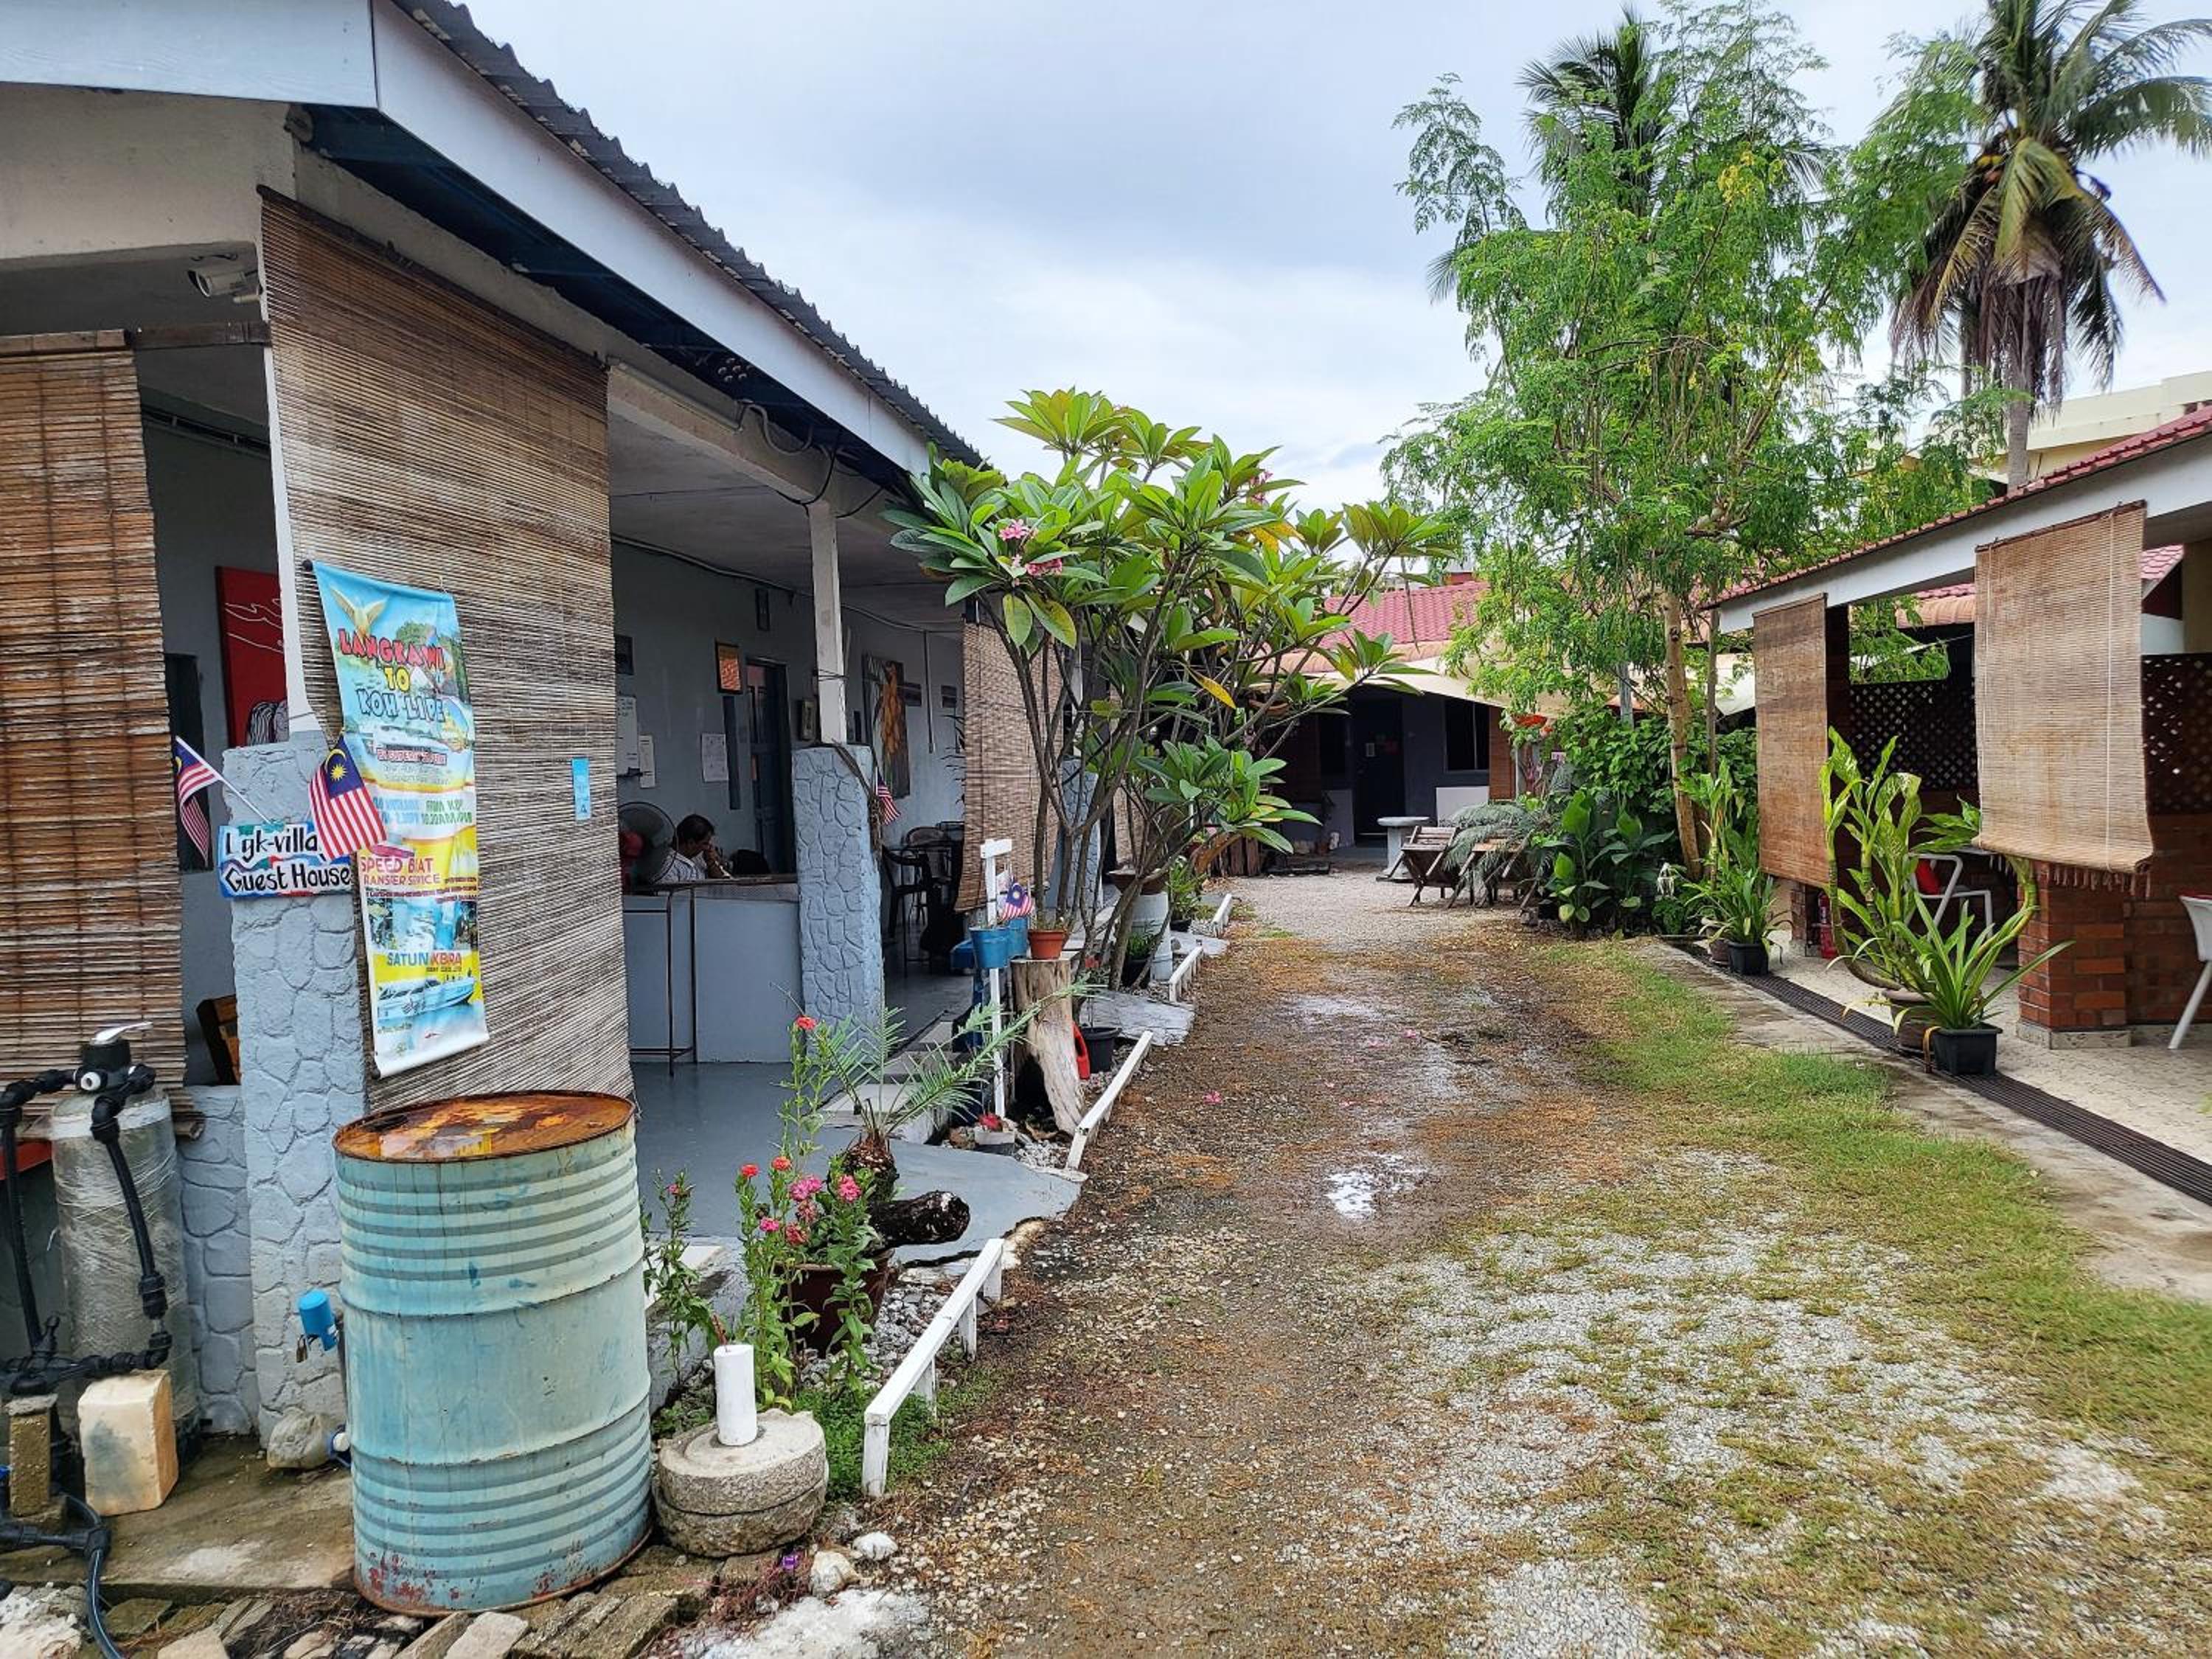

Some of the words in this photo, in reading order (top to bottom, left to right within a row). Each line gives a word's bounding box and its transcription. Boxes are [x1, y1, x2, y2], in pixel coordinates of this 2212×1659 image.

[338, 627, 446, 671] LANGKAWI
[383, 666, 411, 692] TO
[225, 865, 288, 892] Guest
[291, 863, 351, 888] House
[360, 856, 403, 873] SPEED
[388, 951, 429, 967] SATUN
